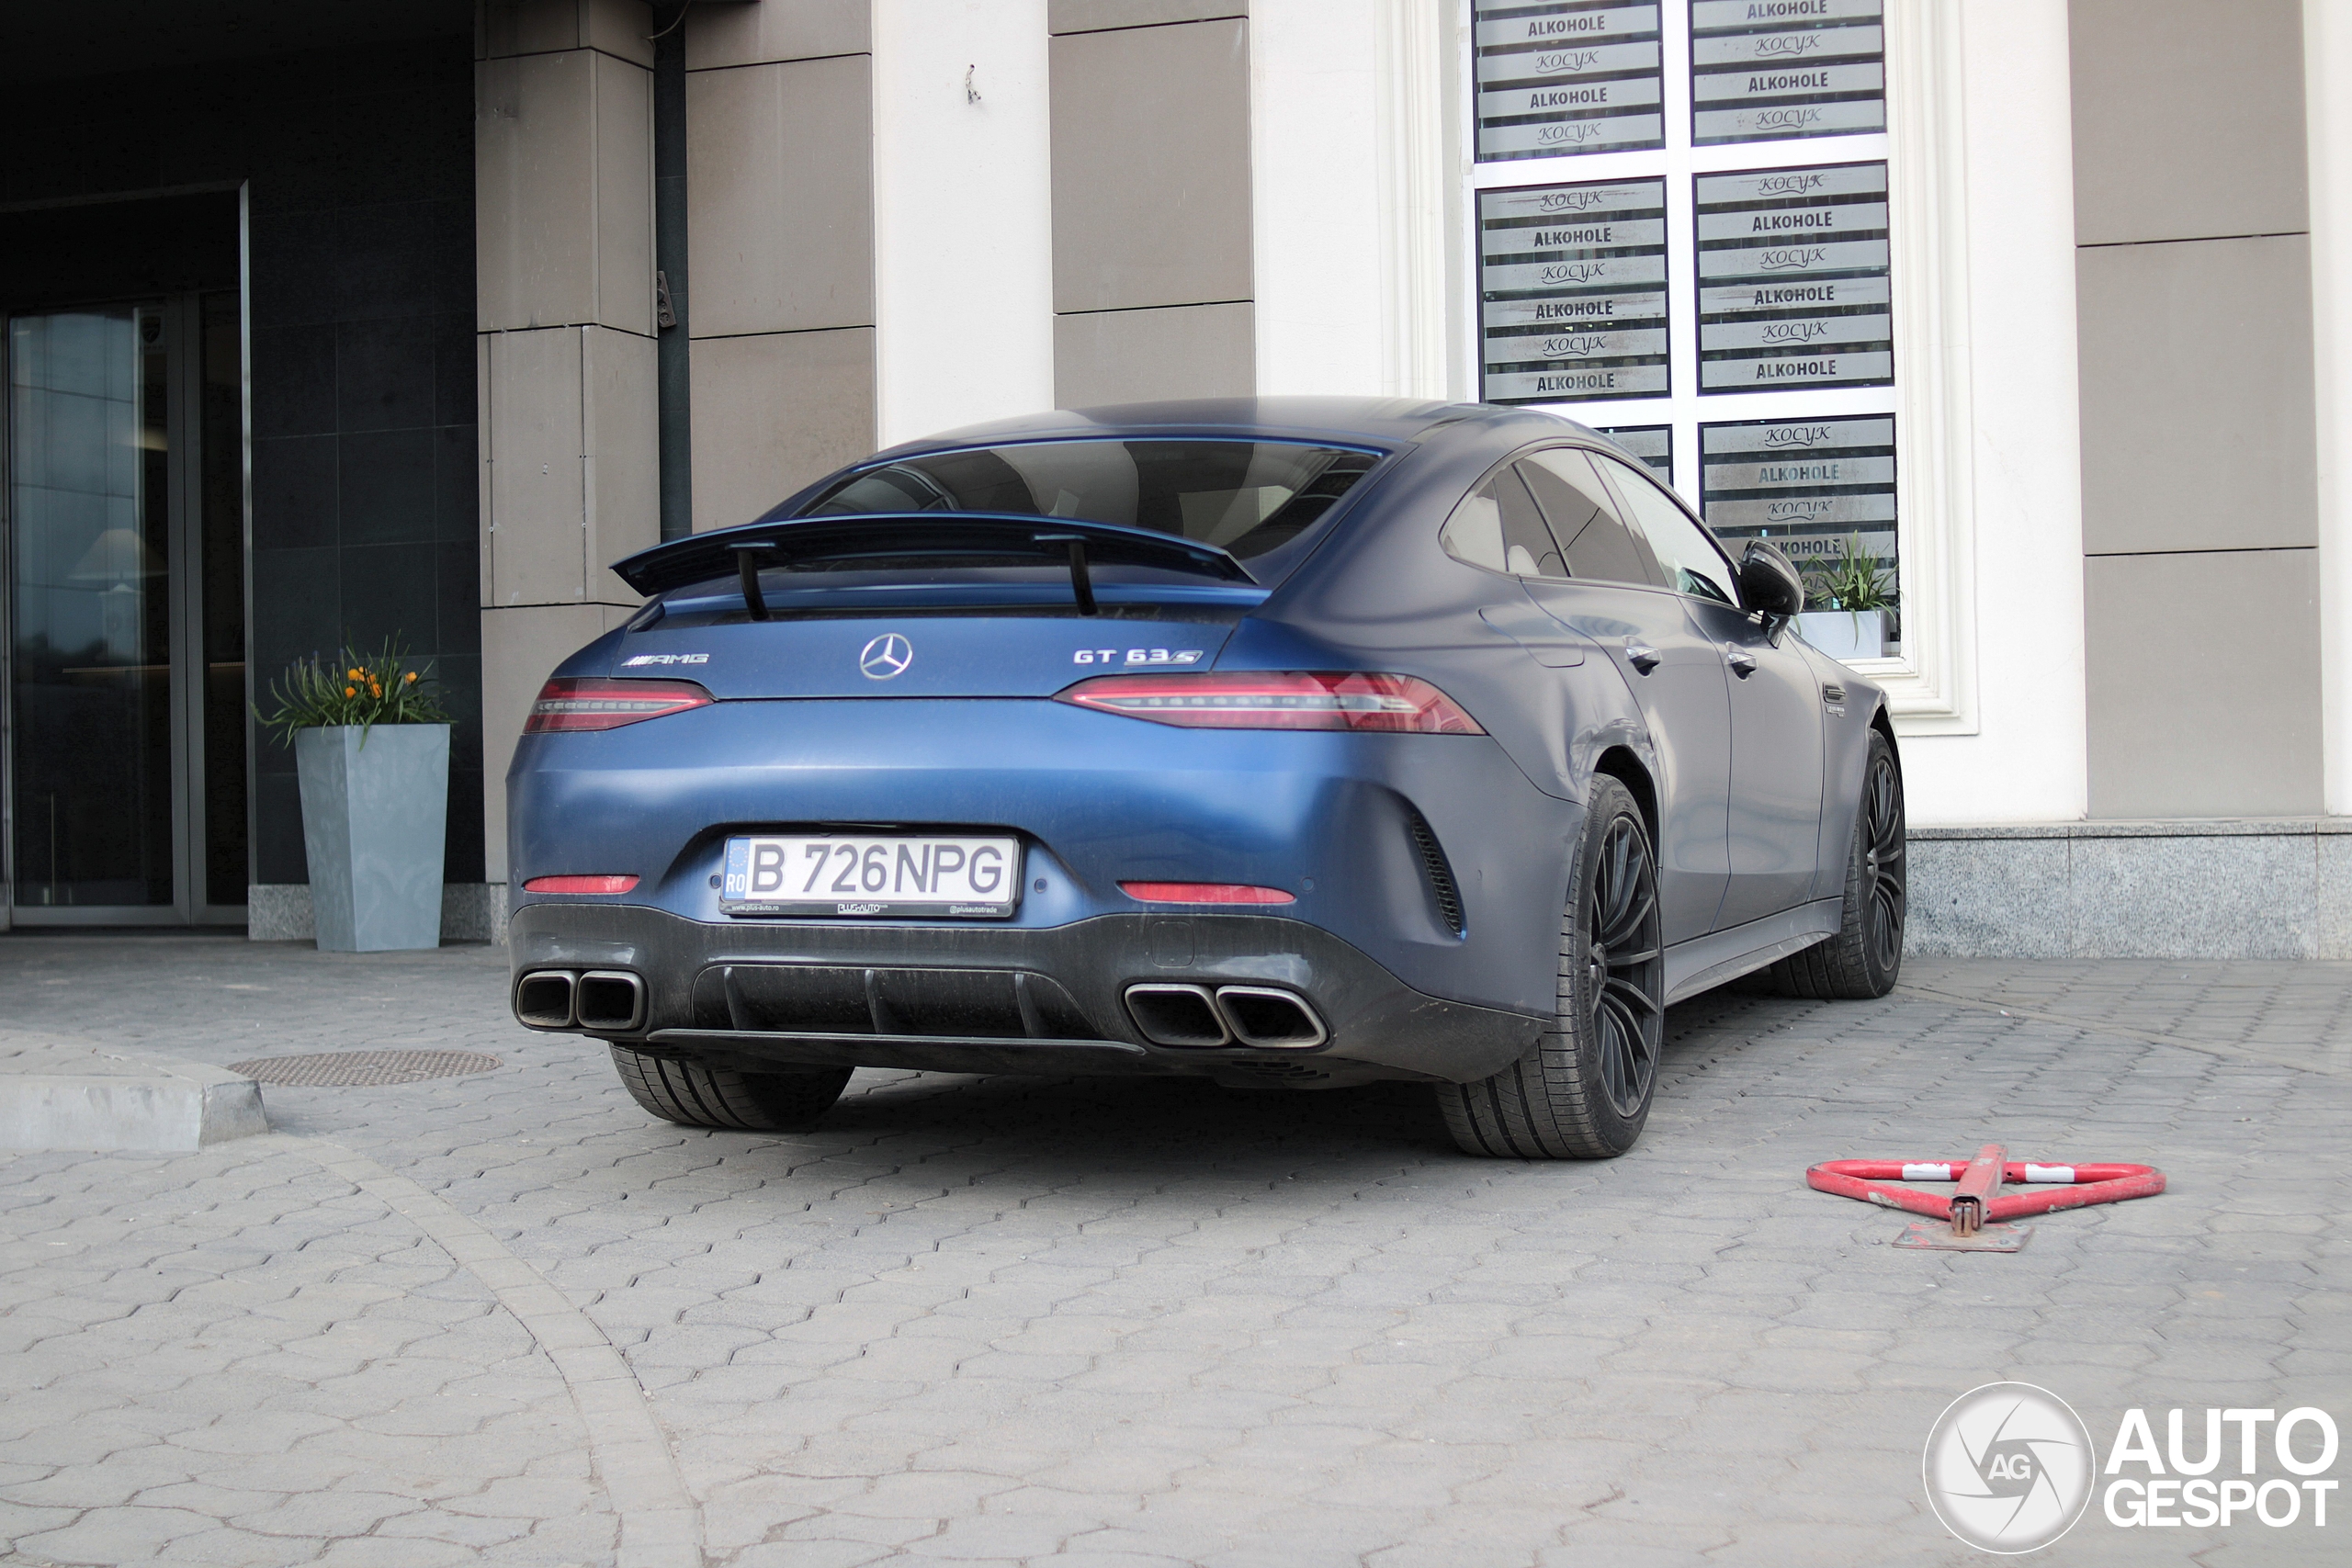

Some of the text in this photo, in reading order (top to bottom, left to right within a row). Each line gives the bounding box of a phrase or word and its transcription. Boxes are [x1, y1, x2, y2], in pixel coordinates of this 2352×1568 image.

[1747, 0, 1827, 19] ALKOHOLE
[1528, 15, 1605, 37] ALKOHOLE
[1748, 72, 1828, 93] ALKOHOLE
[1530, 87, 1608, 108] ALKOHOLE
[1752, 211, 1832, 231] ALKOHOLE
[1533, 227, 1611, 247] ALKOHOLE
[1755, 285, 1834, 306] ALKOHOLE
[1535, 299, 1613, 320] ALKOHOLE
[1756, 359, 1836, 379] ALKOHOLE
[1537, 373, 1614, 392] ALKOHOLE
[1758, 463, 1839, 484] ALKOHOLE
[1771, 538, 1841, 556] KOHOLE
[646, 652, 710, 665] AMG
[1073, 649, 1117, 664] GT
[752, 843, 786, 892] B
[726, 874, 745, 892] RO
[731, 903, 780, 912] www.plus-auto.ro
